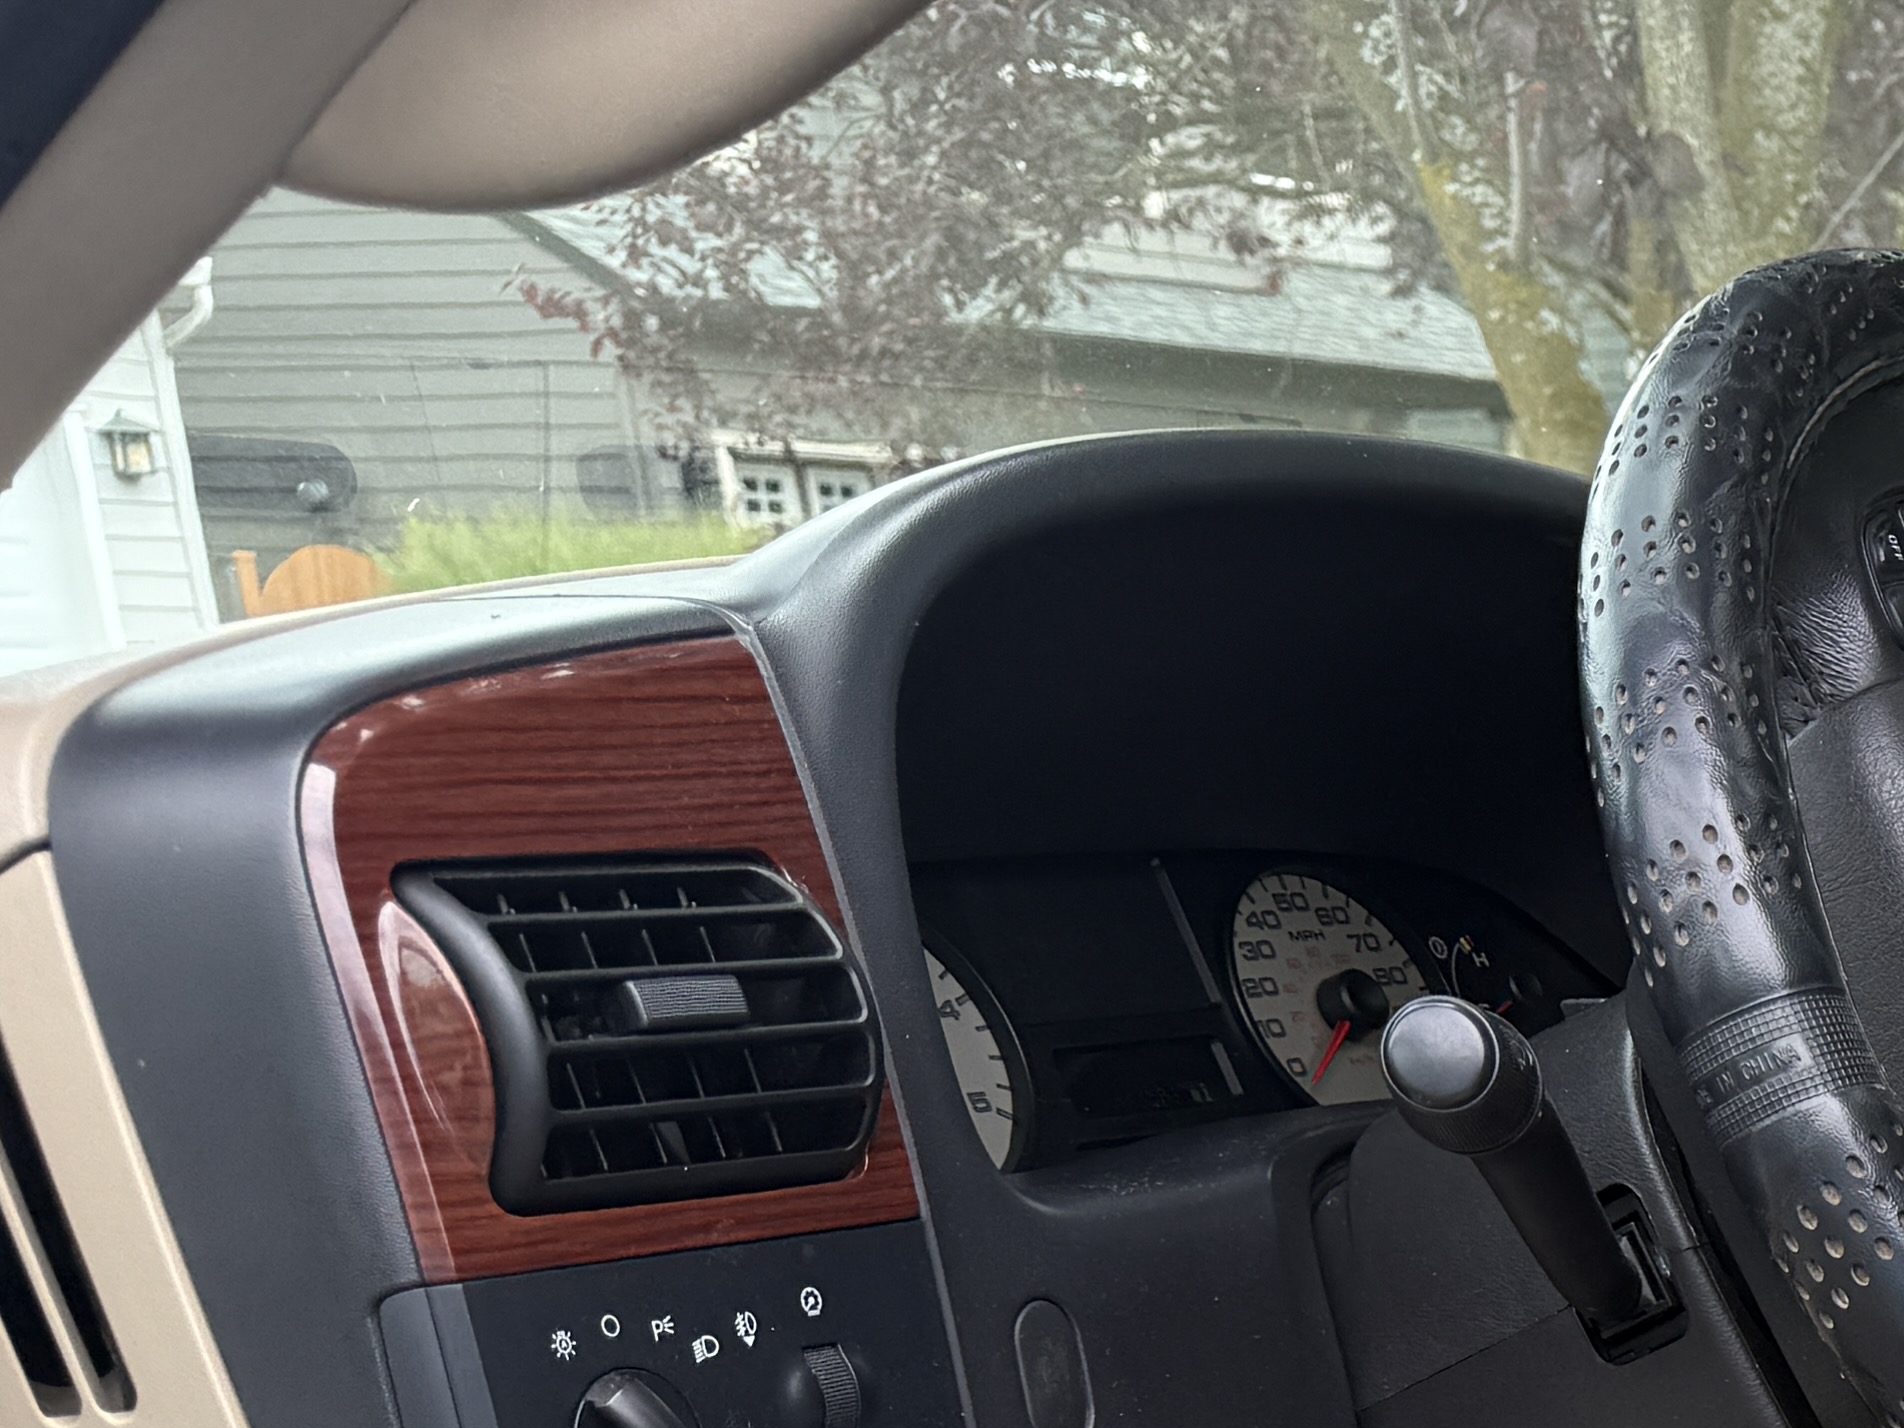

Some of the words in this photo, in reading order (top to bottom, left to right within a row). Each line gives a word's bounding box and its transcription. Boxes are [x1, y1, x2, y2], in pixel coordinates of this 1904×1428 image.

[1888, 534, 1904, 561] OFF
[1272, 892, 1310, 912] 50
[1246, 909, 1282, 930] 40
[1314, 906, 1350, 926] 60
[1288, 929, 1326, 942] MPH
[1346, 933, 1381, 953] 70
[1238, 940, 1277, 961] 30
[1373, 966, 1408, 986] 80
[1242, 976, 1279, 998] 20
[938, 999, 961, 1021] 4
[1257, 1018, 1286, 1039] 10
[1286, 1057, 1308, 1077] 0
[1715, 1071, 1736, 1094] IN
[1739, 1042, 1802, 1081] CHINA
[966, 1091, 993, 1114] 5
